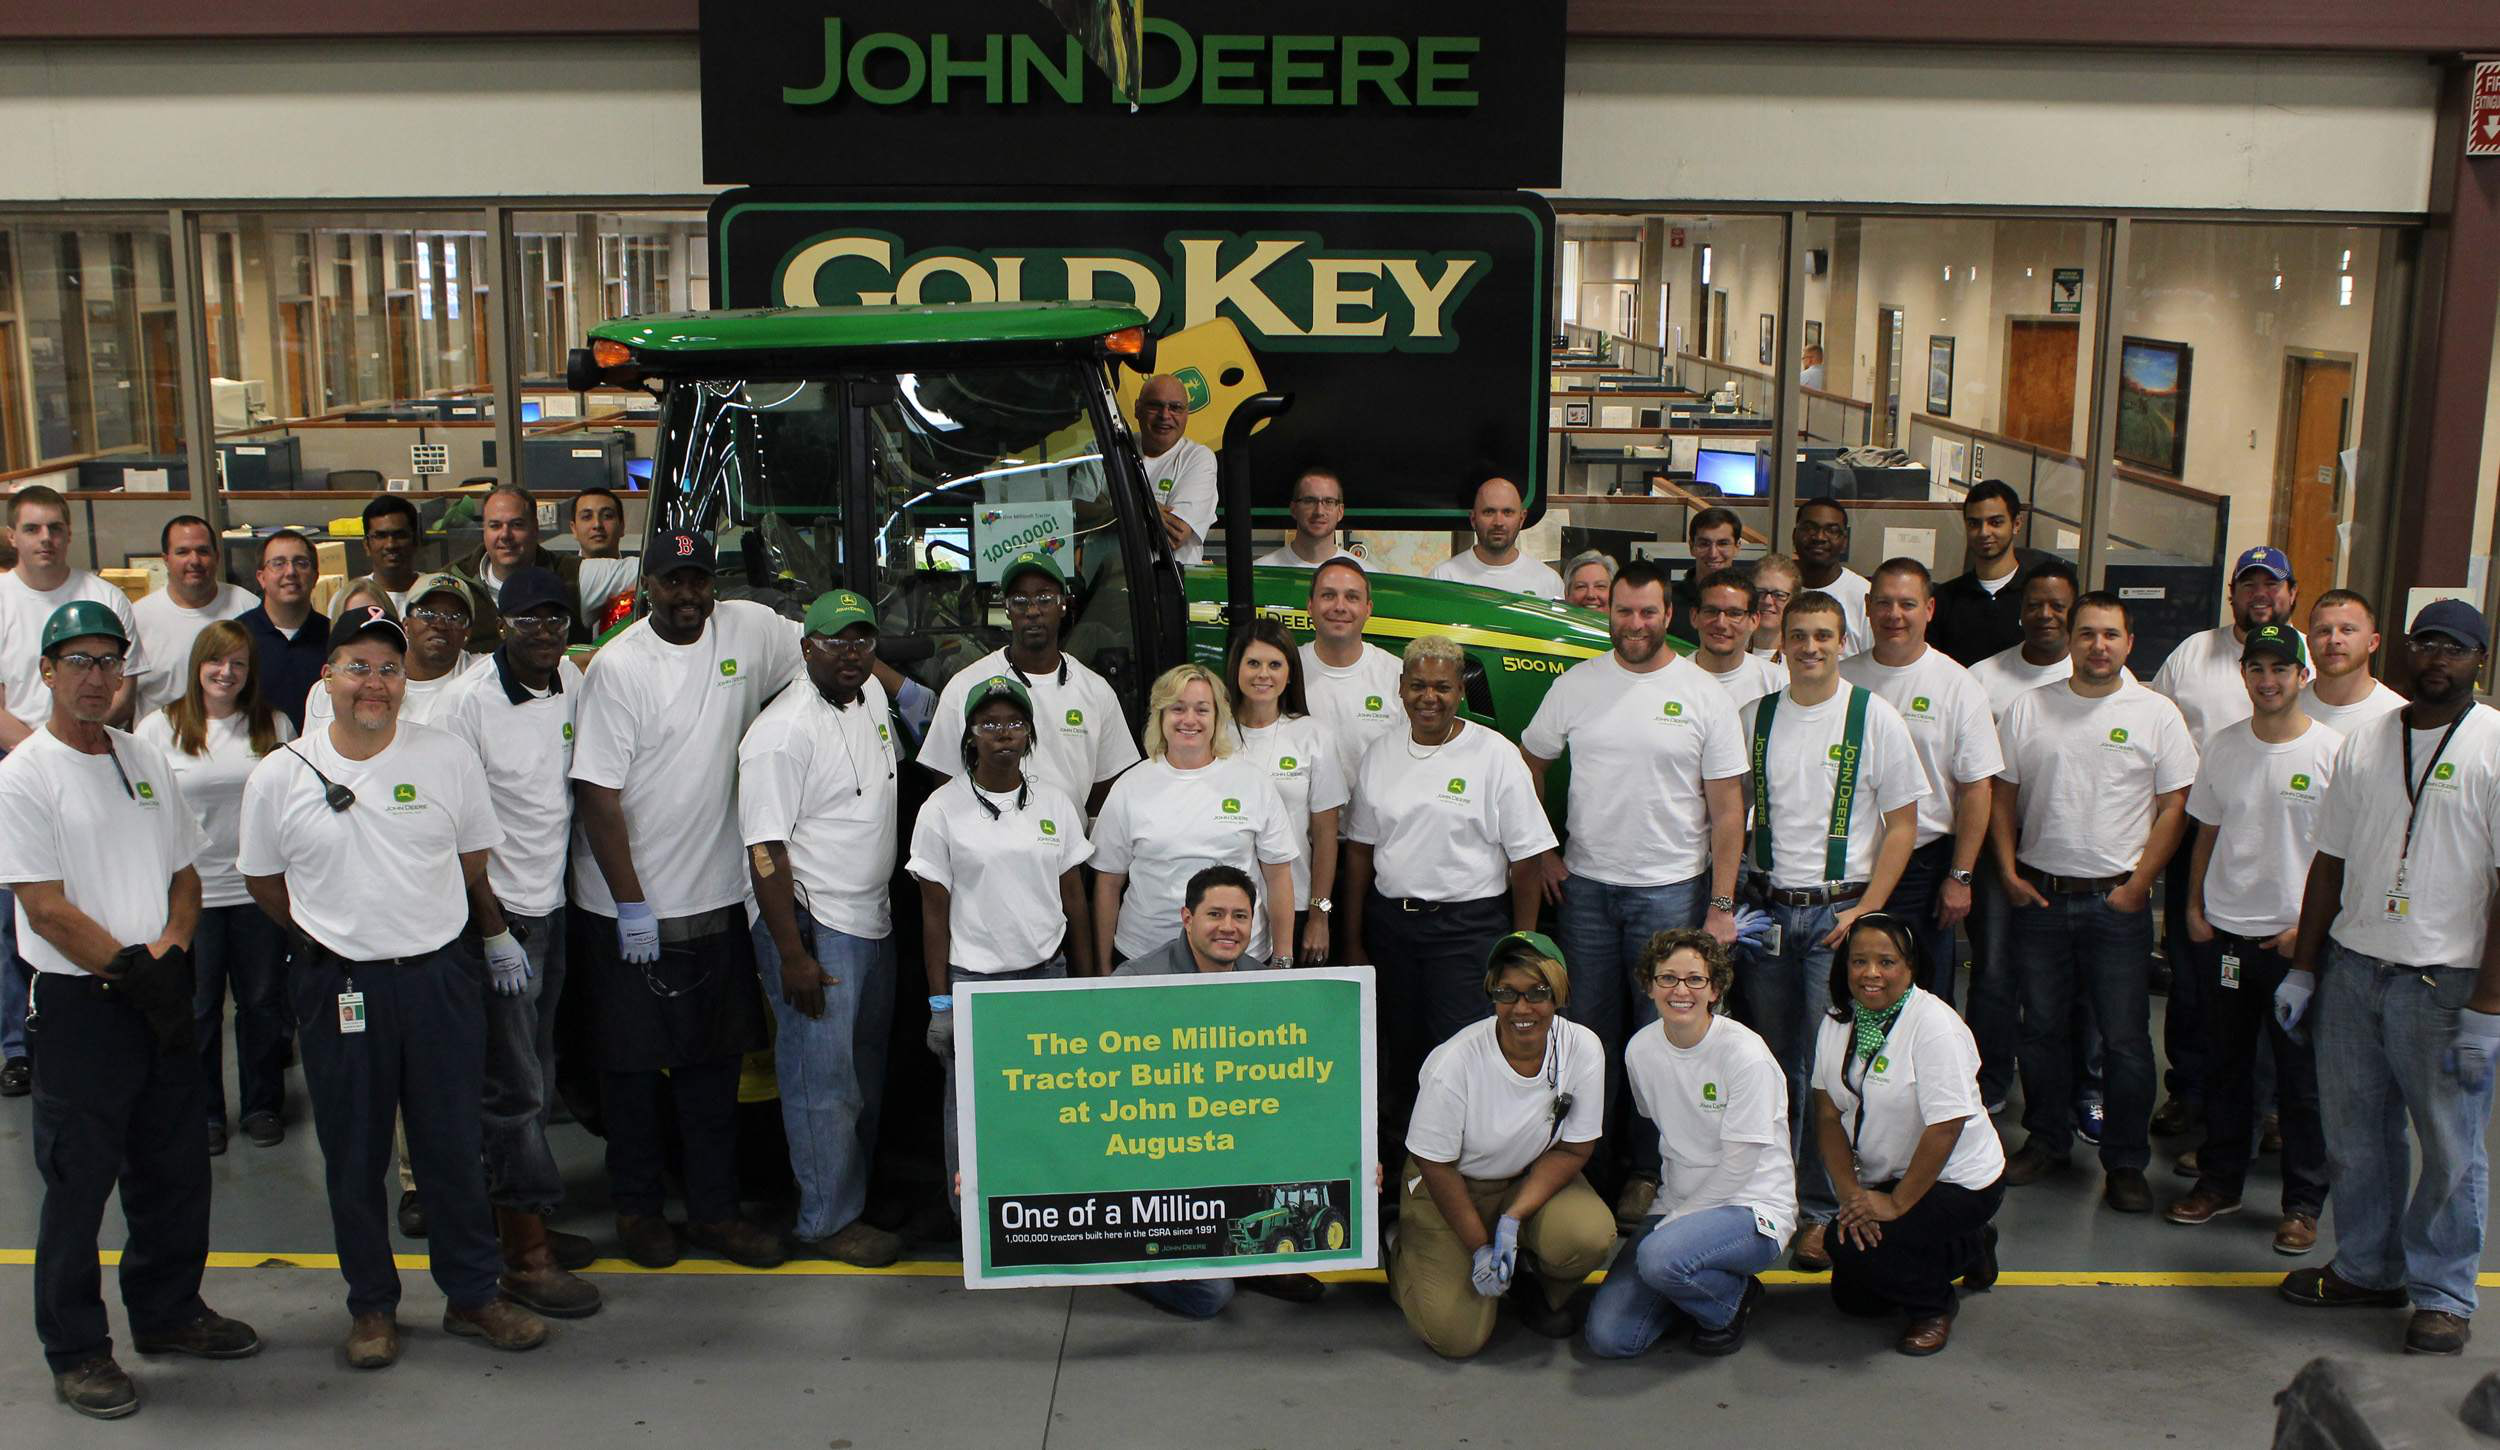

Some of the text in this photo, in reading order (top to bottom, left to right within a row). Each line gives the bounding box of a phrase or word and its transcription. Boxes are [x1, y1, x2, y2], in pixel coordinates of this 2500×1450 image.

[782, 17, 1480, 107] JOHN DEERE
[2485, 76, 2500, 92] FIR
[1178, 239, 1478, 337] KEY
[675, 535, 694, 556] B
[983, 516, 1060, 563] 1,000,000!
[1266, 611, 1316, 630] DEER
[1502, 656, 1565, 676] 5100 M
[1754, 733, 1766, 826] JOHN DEERE
[1835, 740, 1858, 836] JOHN DEERE
[1027, 1023, 1308, 1057] The One Millionth
[1002, 1055, 1334, 1091] Tractor Built Proudly
[1058, 1093, 1280, 1124] at John Deere
[1105, 1129, 1235, 1160] Augusta
[1001, 1194, 1226, 1229] One of a Million
[1005, 1225, 1217, 1243] 1,000,000 tractors built here in the CSRA since 1991
